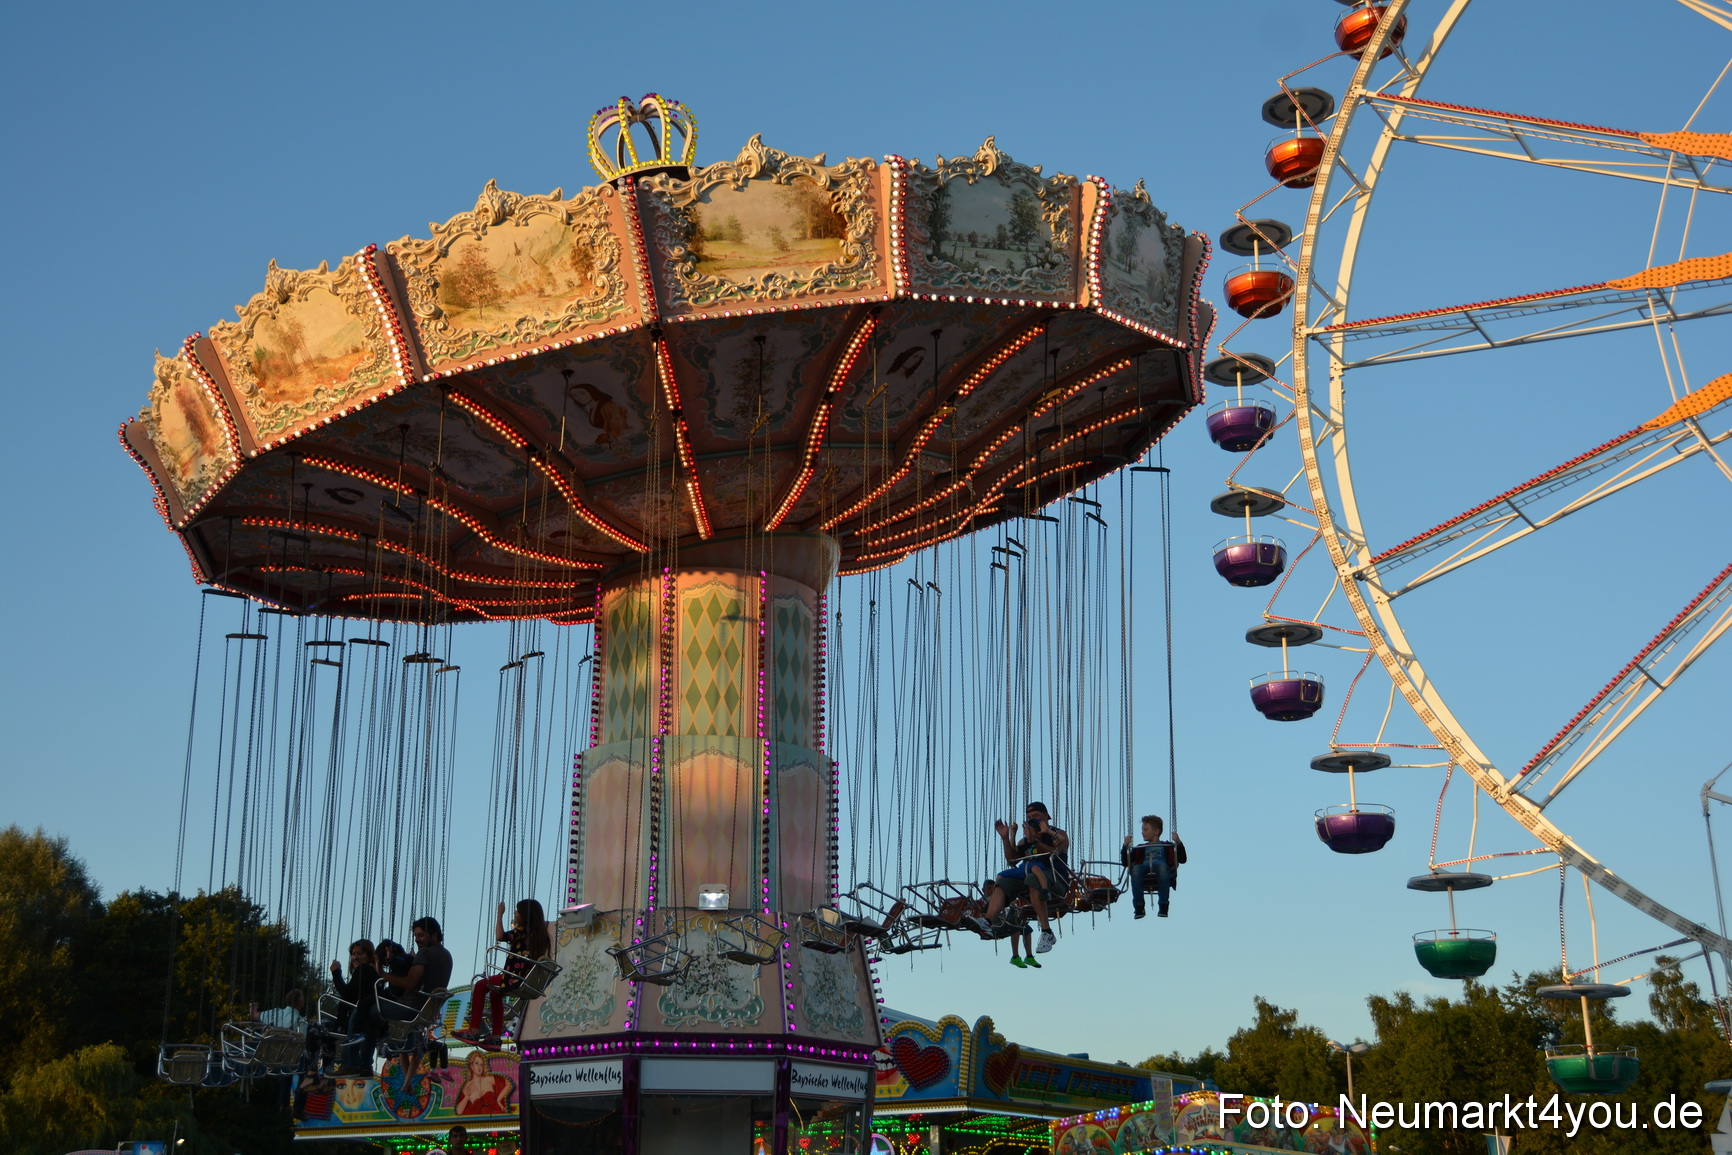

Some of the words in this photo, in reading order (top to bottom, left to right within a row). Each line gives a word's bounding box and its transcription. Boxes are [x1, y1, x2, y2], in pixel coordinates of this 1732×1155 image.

[529, 1070, 572, 1088] Bayrischer
[575, 1066, 622, 1084] Wellenflug
[791, 1068, 829, 1088] Bayrischer
[831, 1074, 868, 1095] Wellenflug
